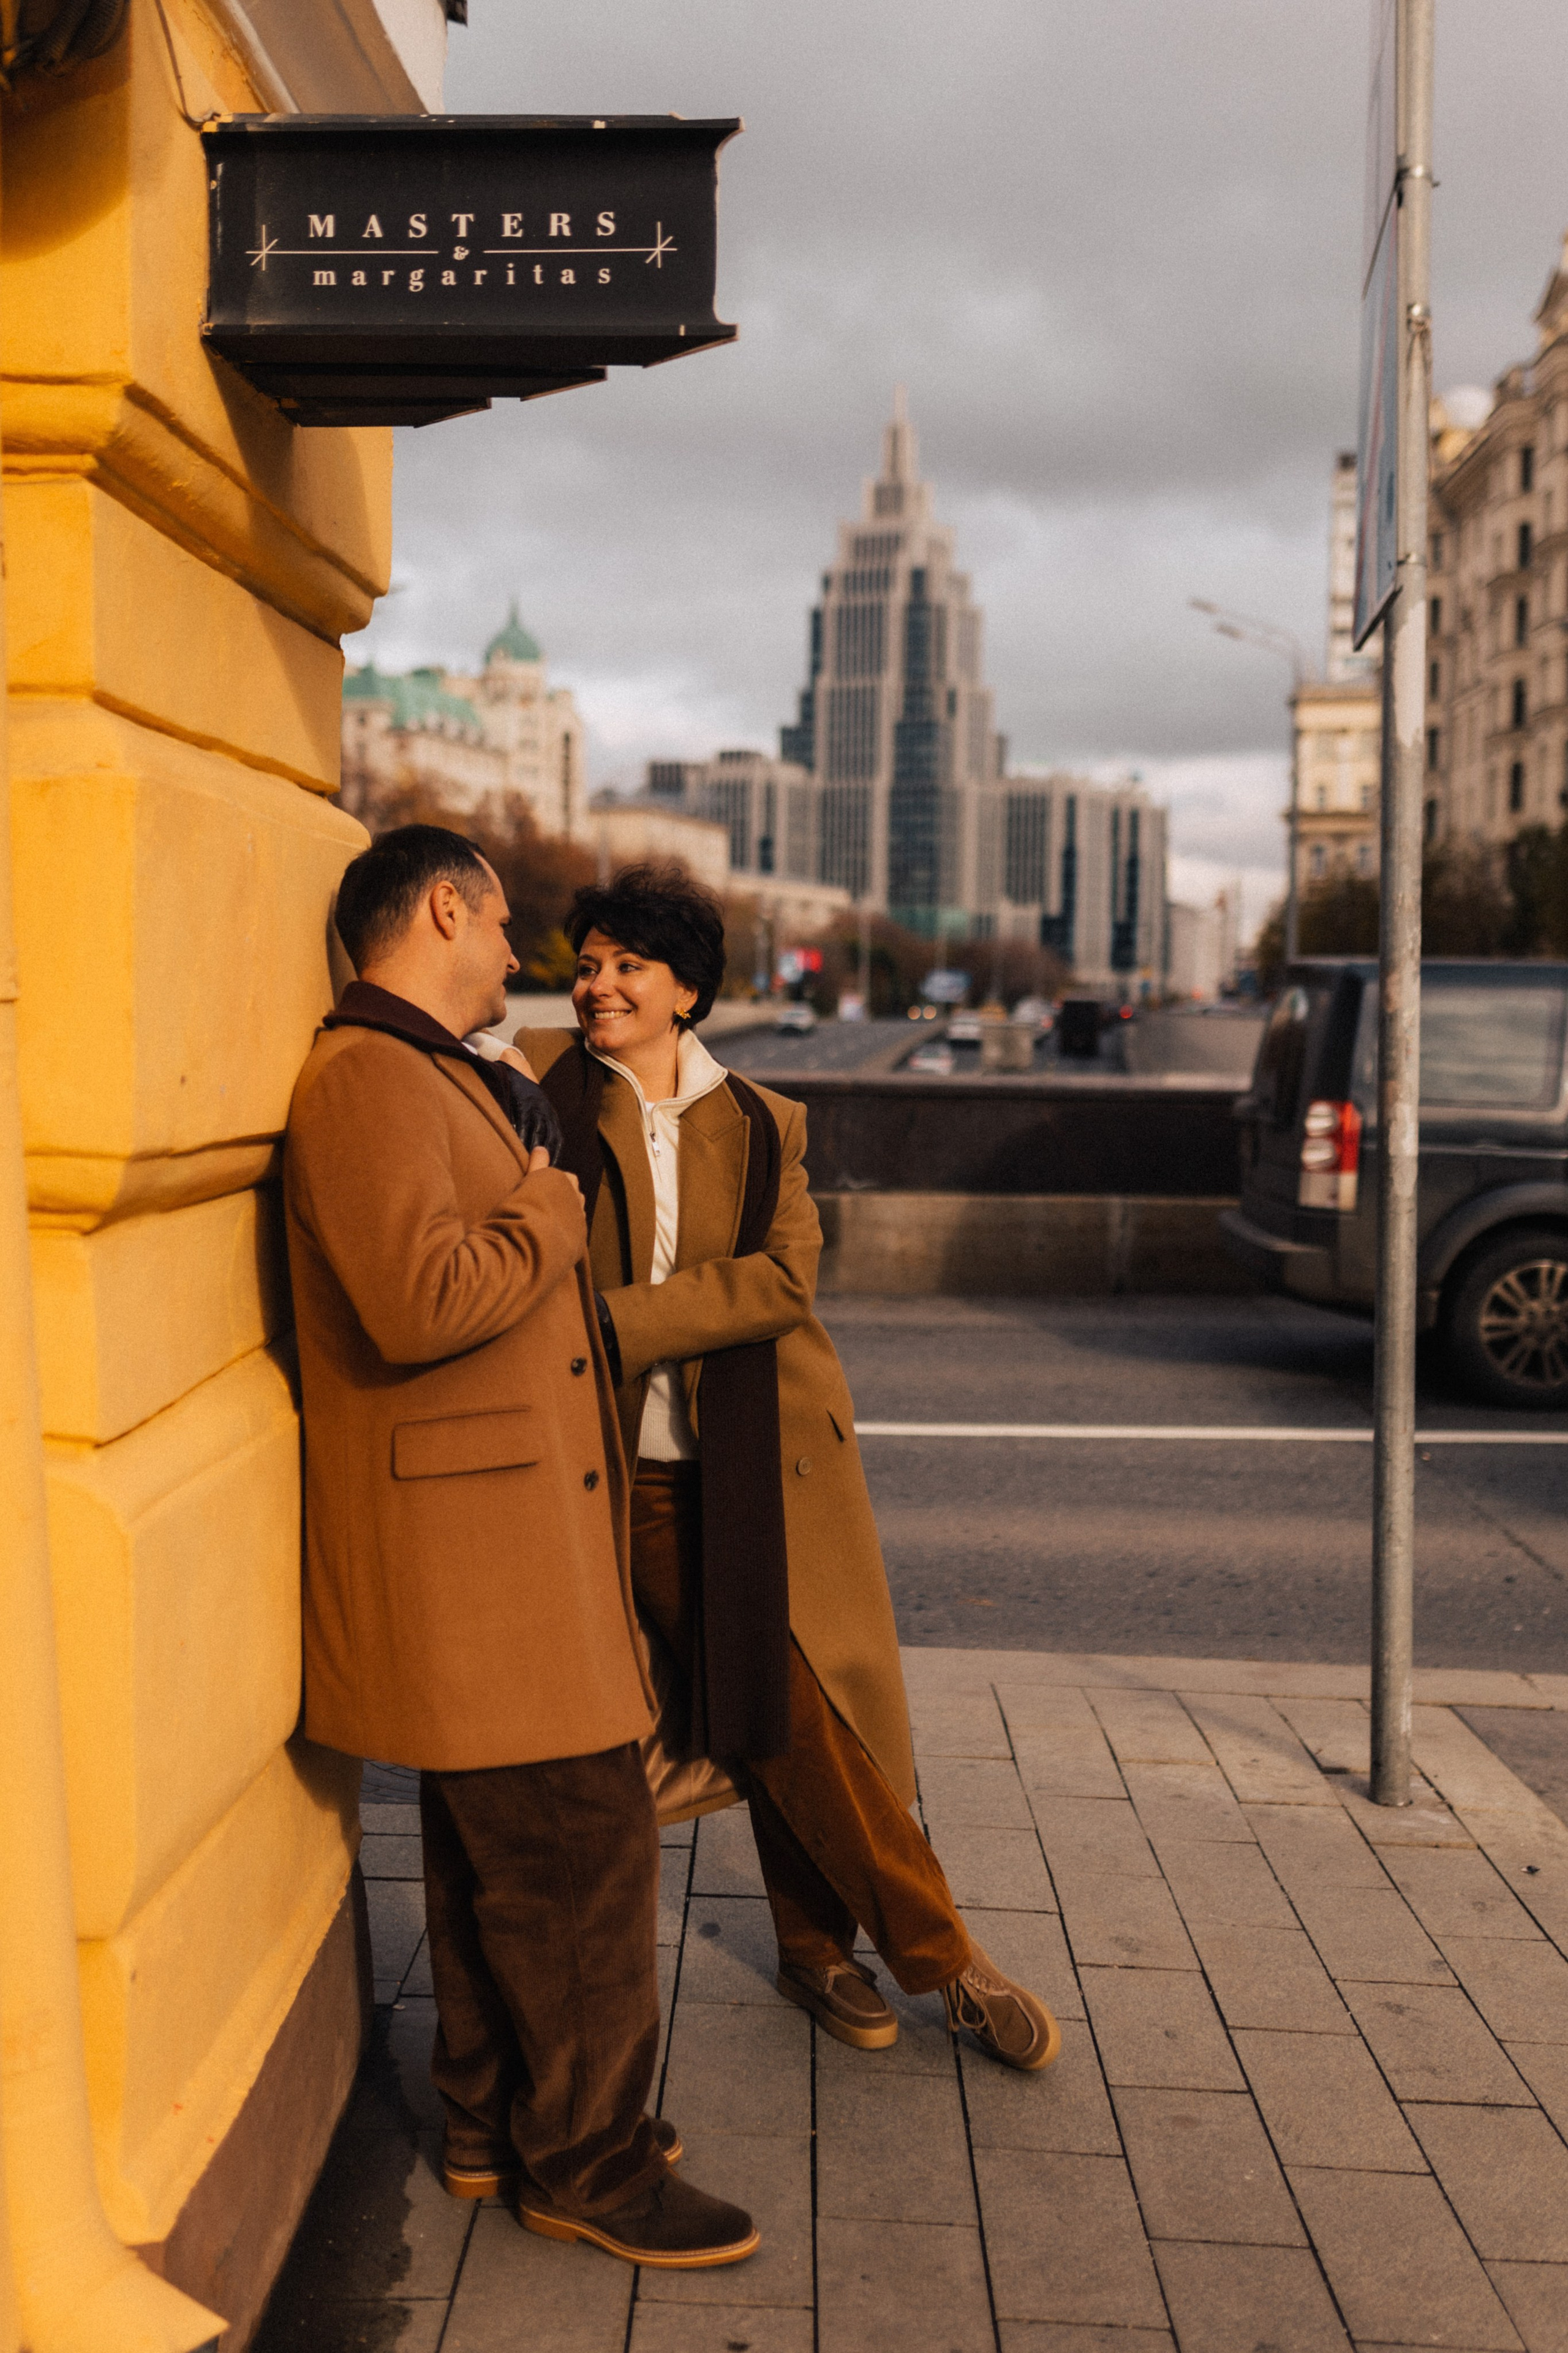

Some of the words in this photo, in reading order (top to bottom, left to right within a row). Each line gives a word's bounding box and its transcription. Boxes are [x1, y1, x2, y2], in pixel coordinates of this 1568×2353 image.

[307, 211, 617, 239] MASTERS
[453, 245, 470, 261] &
[312, 263, 611, 293] margaritas
